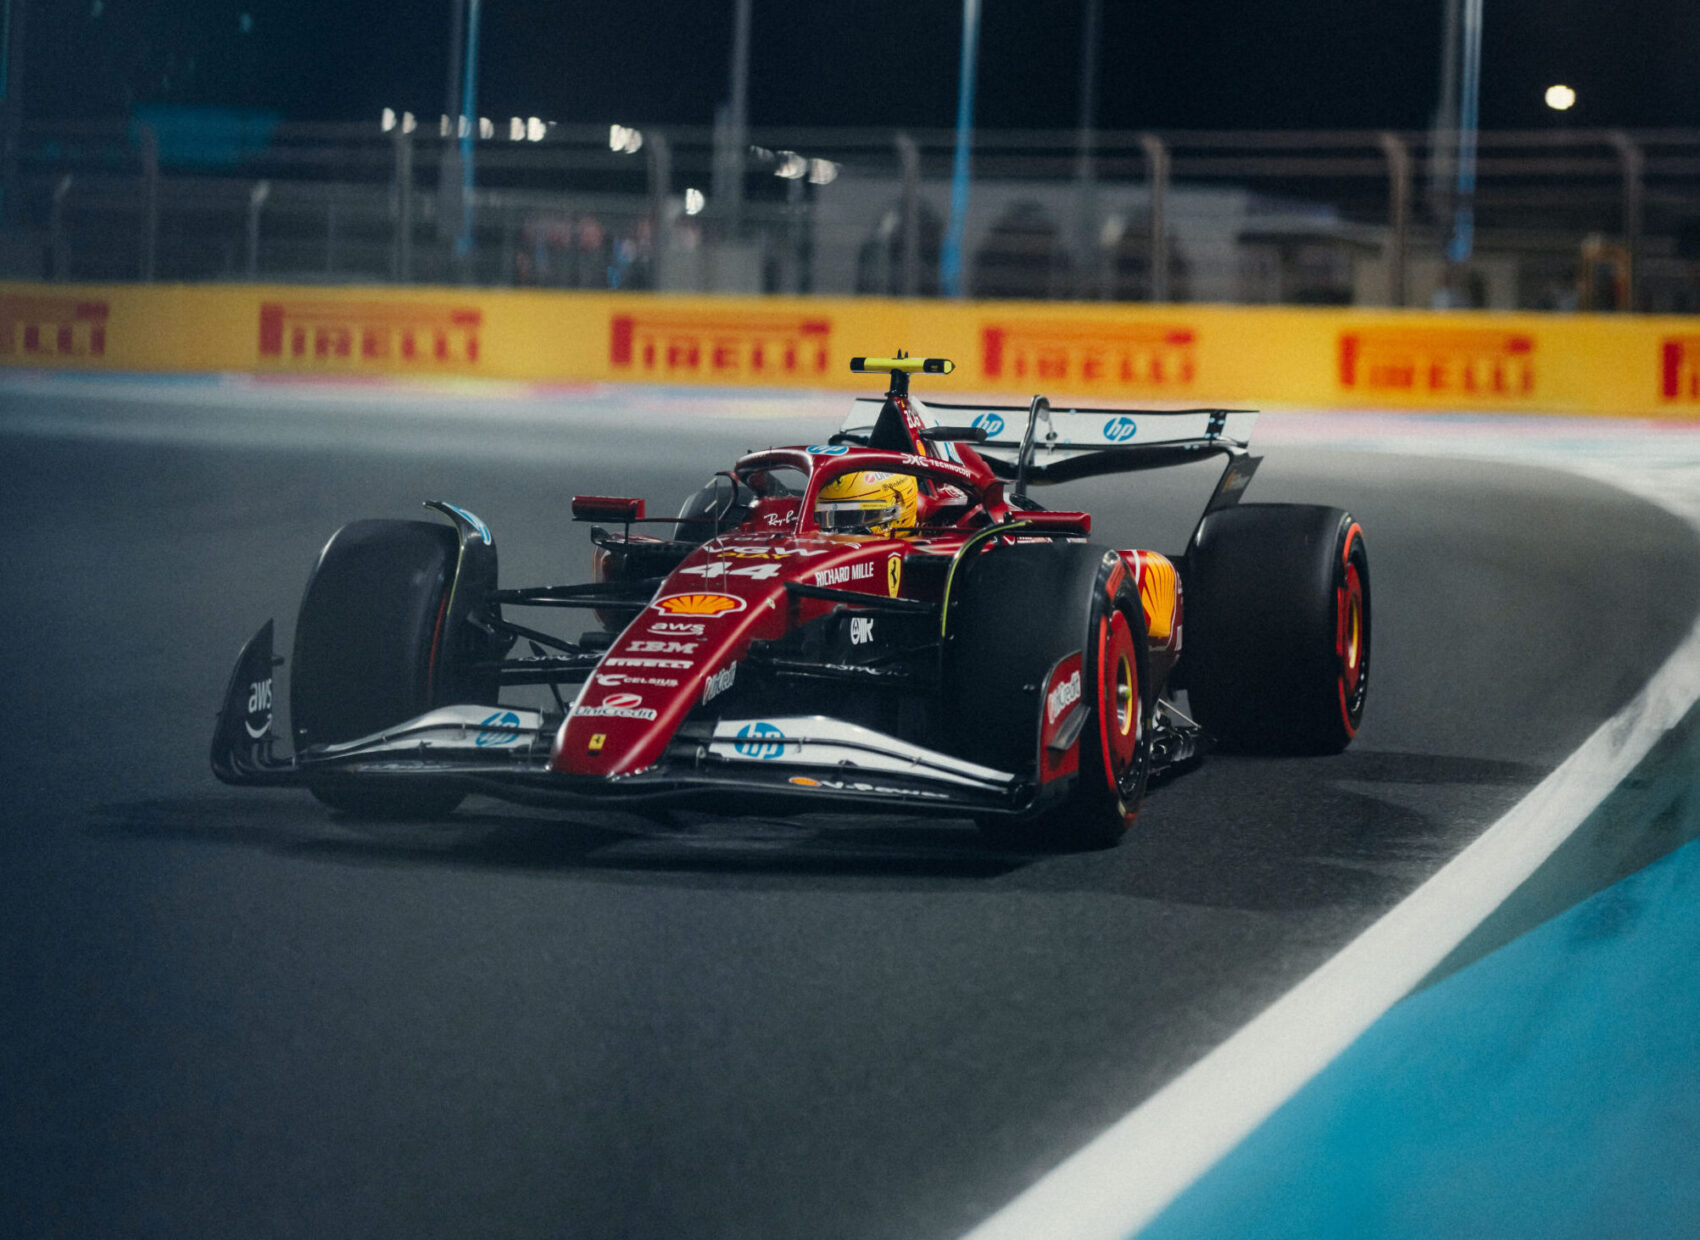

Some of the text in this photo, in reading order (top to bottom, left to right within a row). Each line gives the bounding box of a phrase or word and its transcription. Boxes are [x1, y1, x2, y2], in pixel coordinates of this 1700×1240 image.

[971, 413, 1004, 439] hp
[1103, 417, 1137, 442] hp
[931, 460, 971, 478] TECHNOLOGY
[716, 552, 792, 560] PLAY
[680, 561, 782, 580] 44
[814, 561, 875, 587] RICHARD MILLE
[650, 622, 706, 635] aws
[625, 640, 699, 654] IBM
[605, 658, 694, 669] PIRELLI
[734, 722, 786, 759] hp
